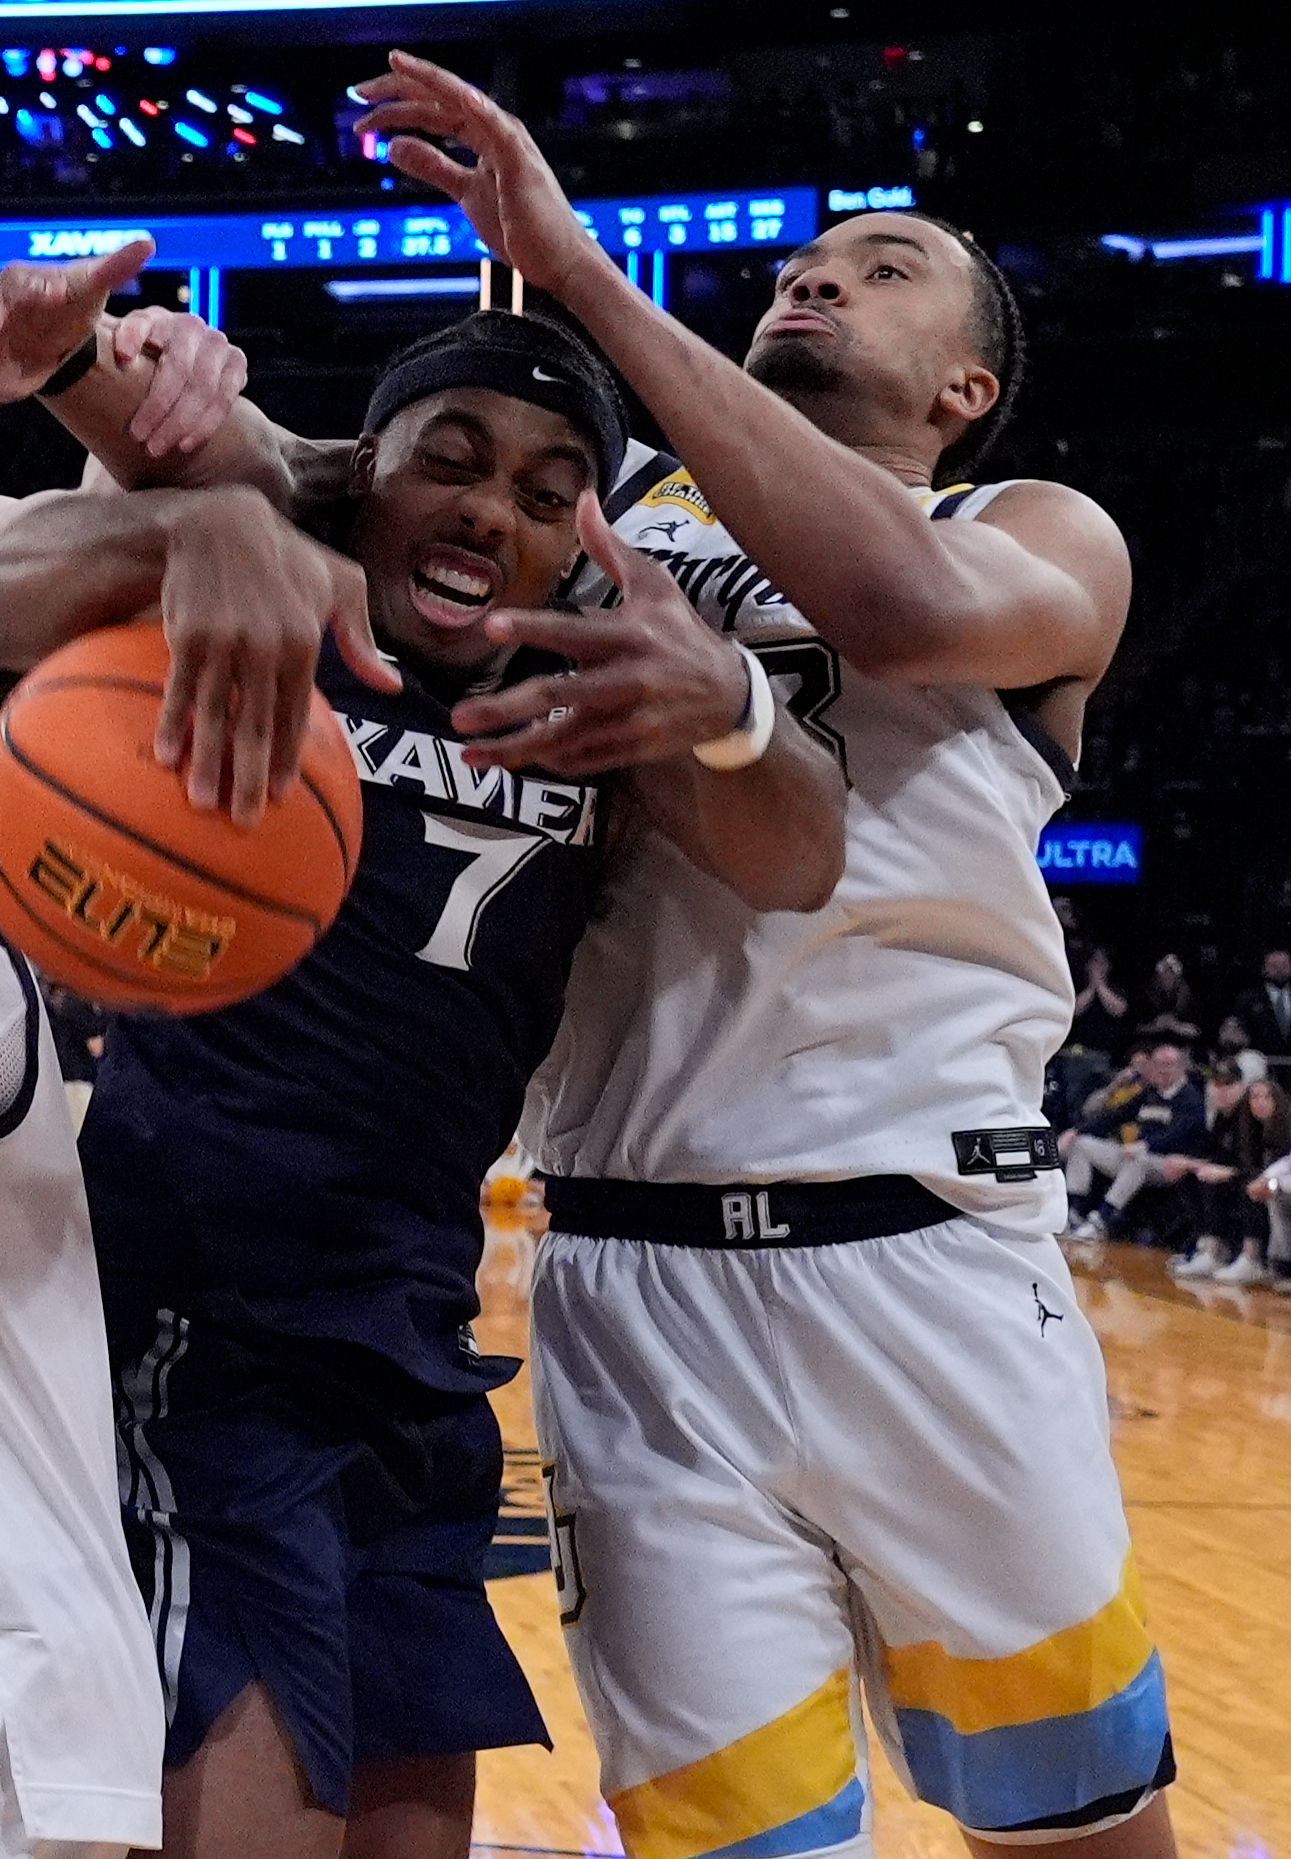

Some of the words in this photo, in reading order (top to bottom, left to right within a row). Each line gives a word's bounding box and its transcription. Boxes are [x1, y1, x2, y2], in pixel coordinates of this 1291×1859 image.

[26, 837, 230, 978] ELITE
[414, 808, 553, 971] 7
[721, 1190, 791, 1240] AL
